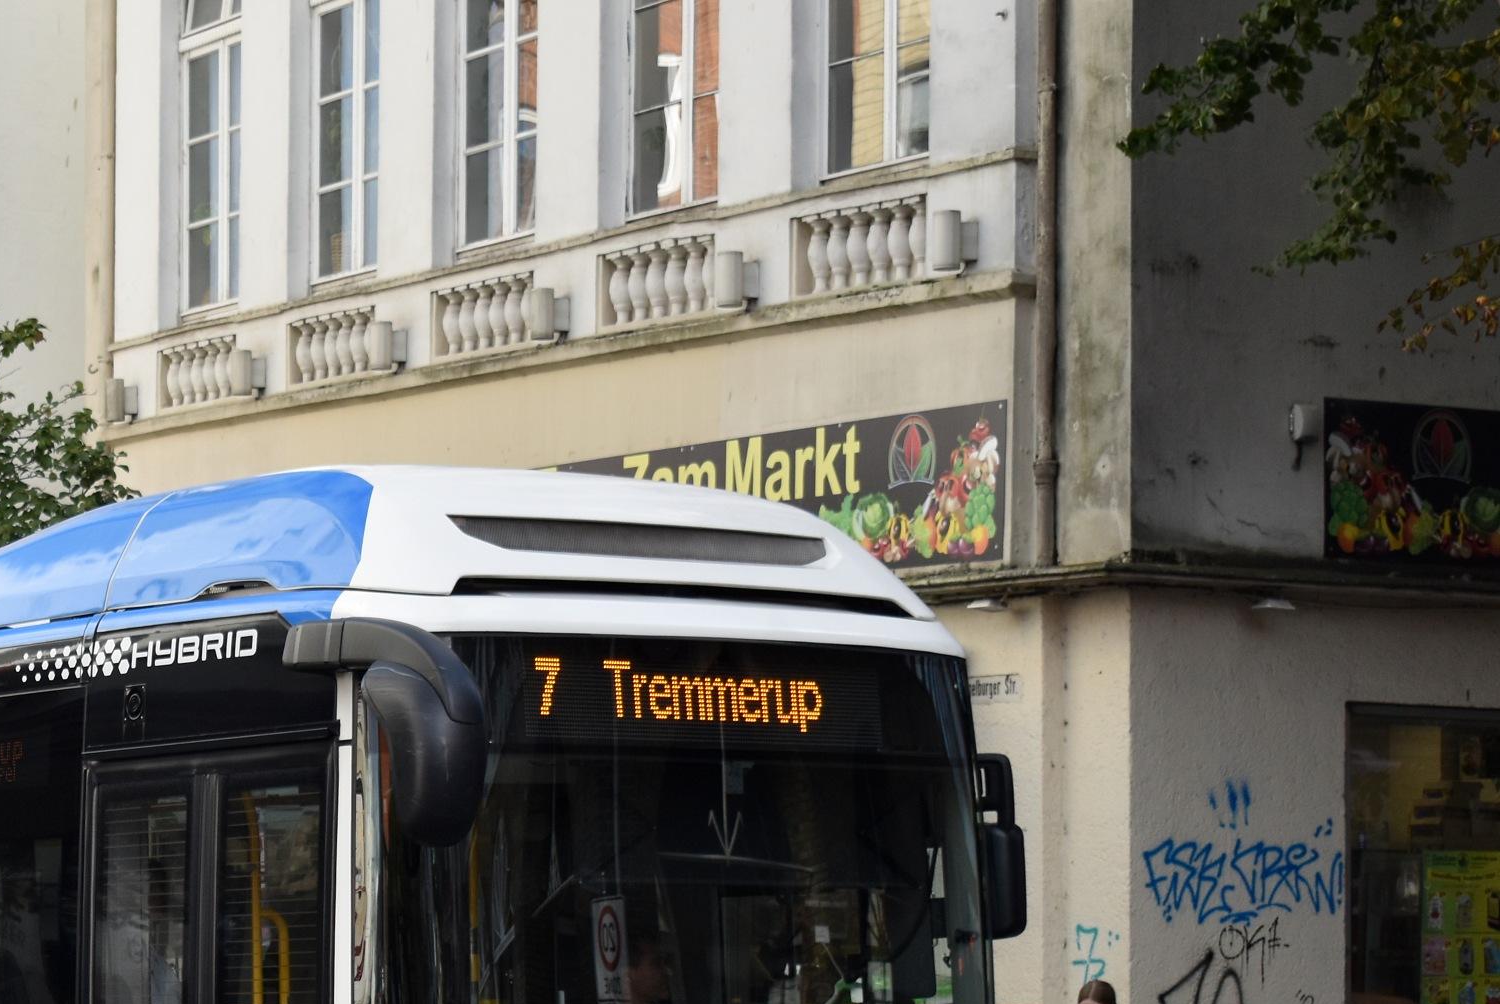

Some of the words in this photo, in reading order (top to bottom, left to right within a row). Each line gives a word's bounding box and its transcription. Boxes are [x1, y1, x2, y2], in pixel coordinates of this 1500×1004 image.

[725, 425, 861, 502] Markt
[131, 629, 258, 669] HYBRID
[534, 656, 561, 716] 7
[603, 660, 823, 733] Tremmerup
